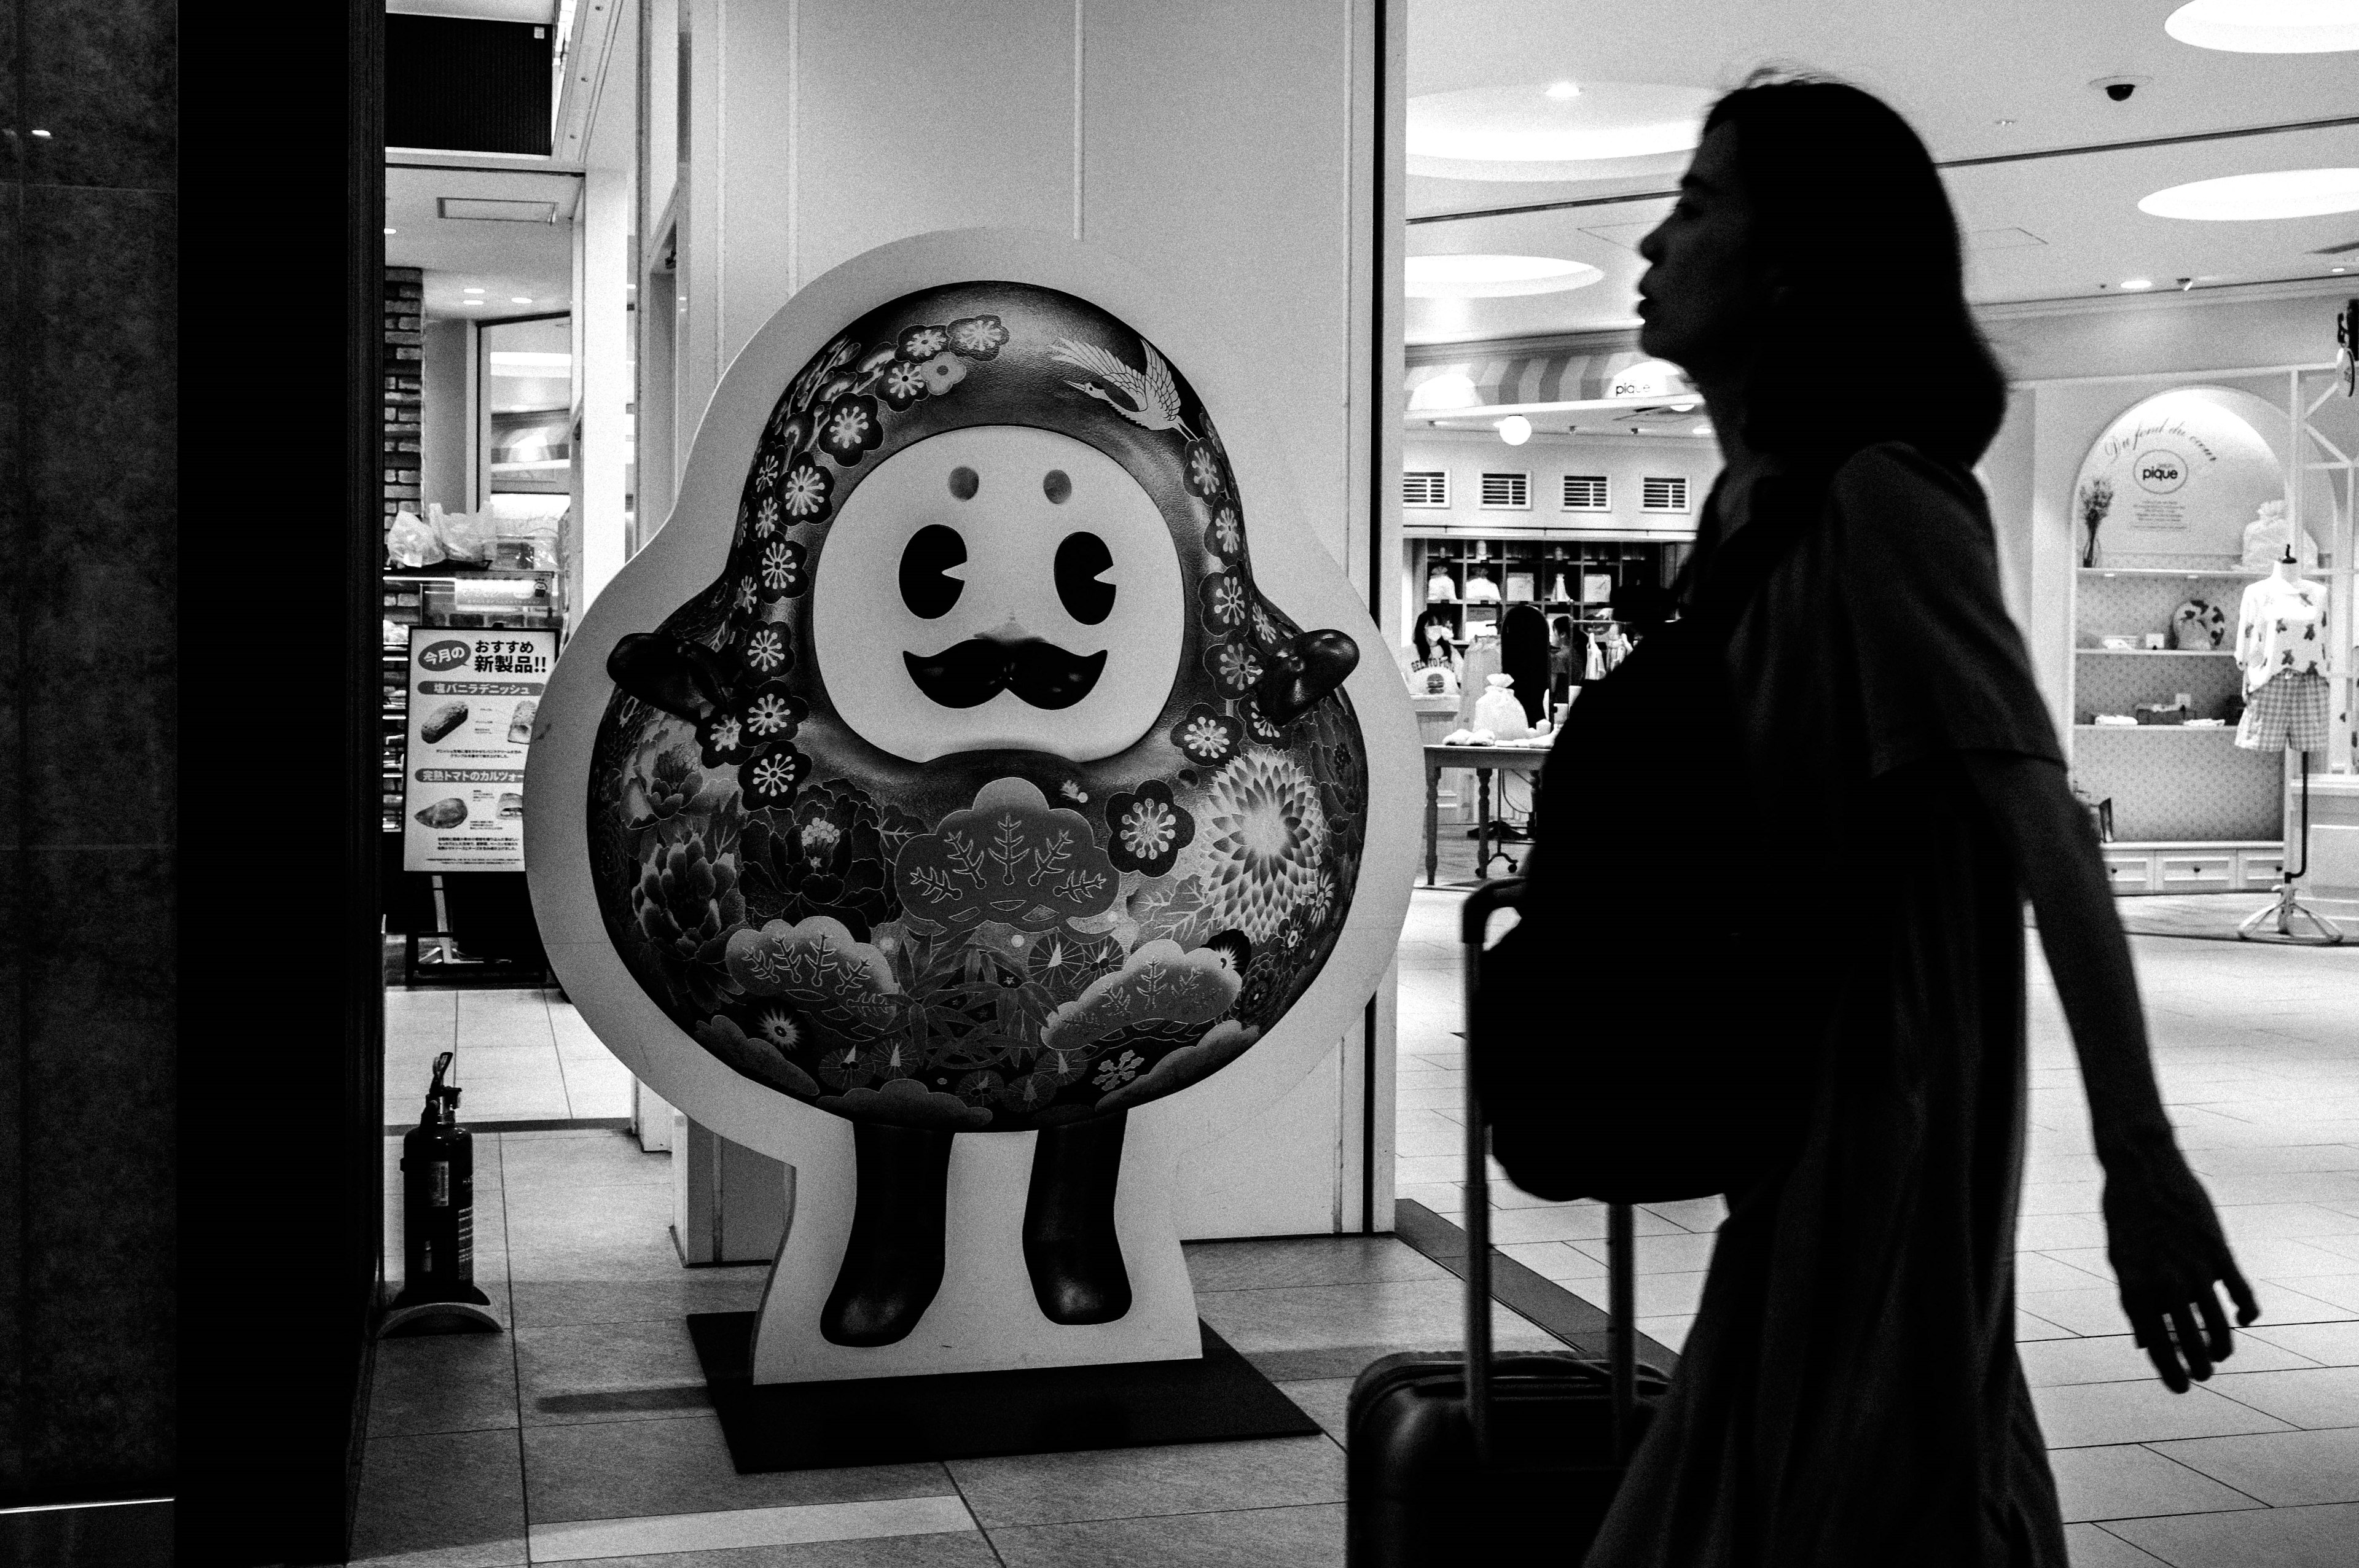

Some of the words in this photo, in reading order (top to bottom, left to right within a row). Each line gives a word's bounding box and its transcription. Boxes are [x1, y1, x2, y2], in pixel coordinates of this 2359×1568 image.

[1616, 382, 1650, 397] pique
[2143, 466, 2178, 481] pique
[475, 640, 534, 653] おすすめ
[423, 646, 465, 665] 今月の
[474, 655, 546, 673] 新製品!!
[434, 682, 530, 695] 塩バニラデニッシュ
